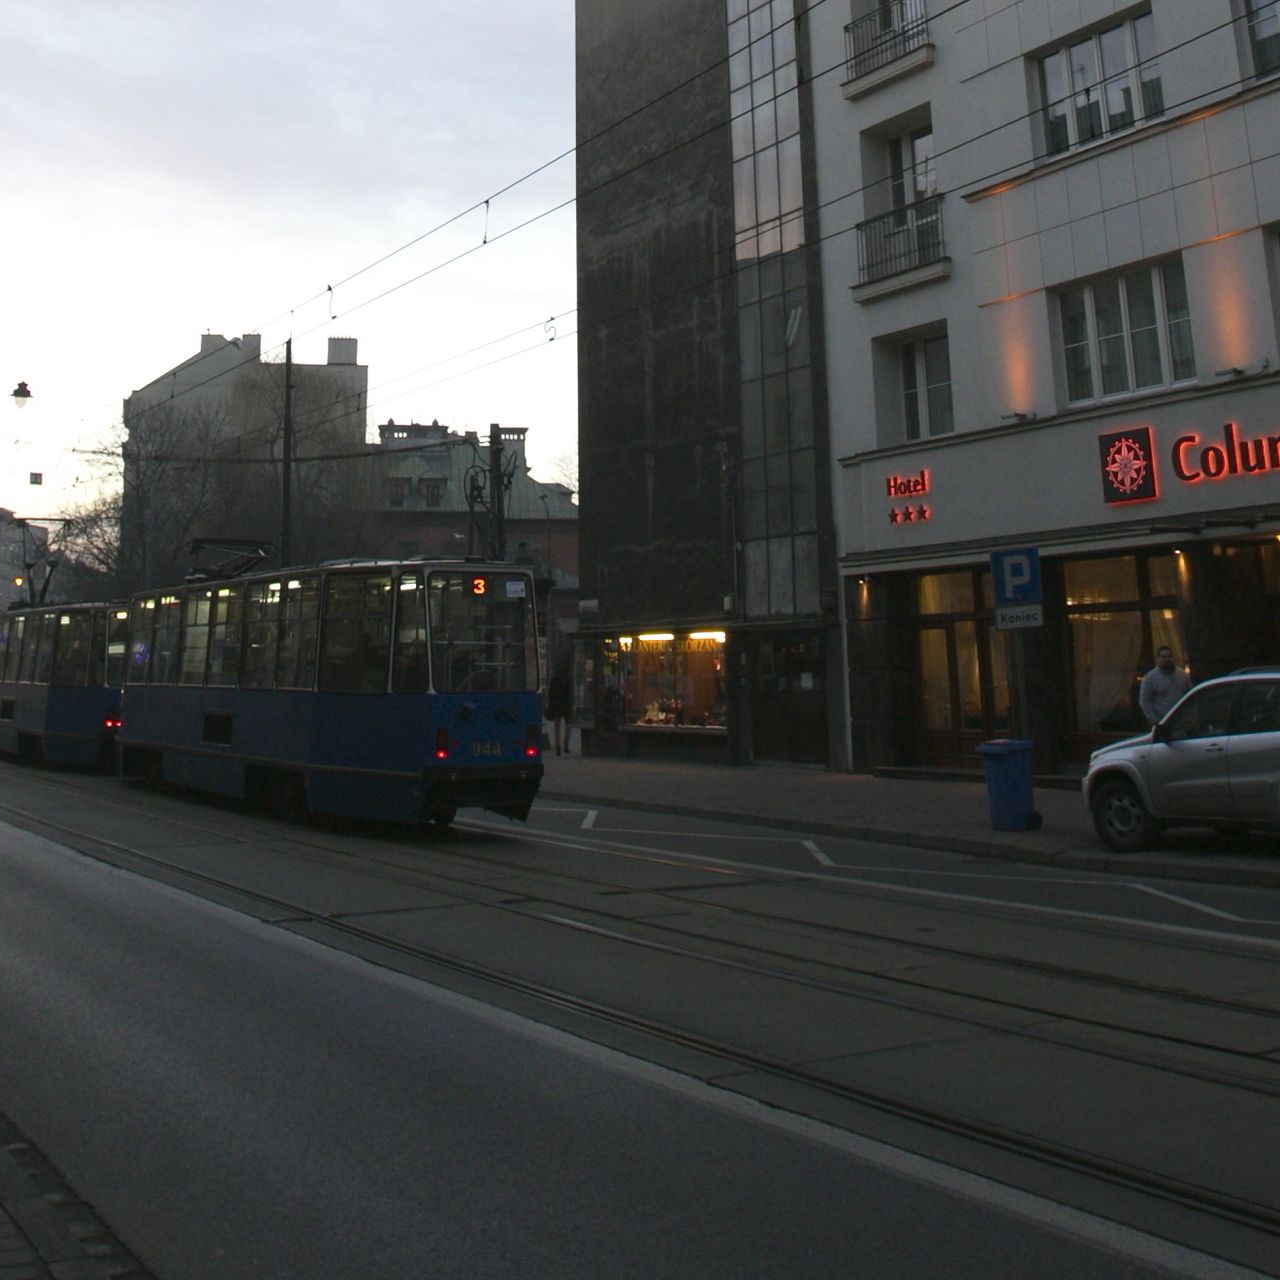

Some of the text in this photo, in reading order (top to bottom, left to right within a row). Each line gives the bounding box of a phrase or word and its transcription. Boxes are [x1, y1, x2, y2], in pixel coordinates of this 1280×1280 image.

[885, 469, 928, 496] Hotel
[1002, 554, 1031, 599] P
[472, 577, 487, 595] 3
[1000, 611, 1039, 624] Koniec
[472, 742, 501, 757] 944
